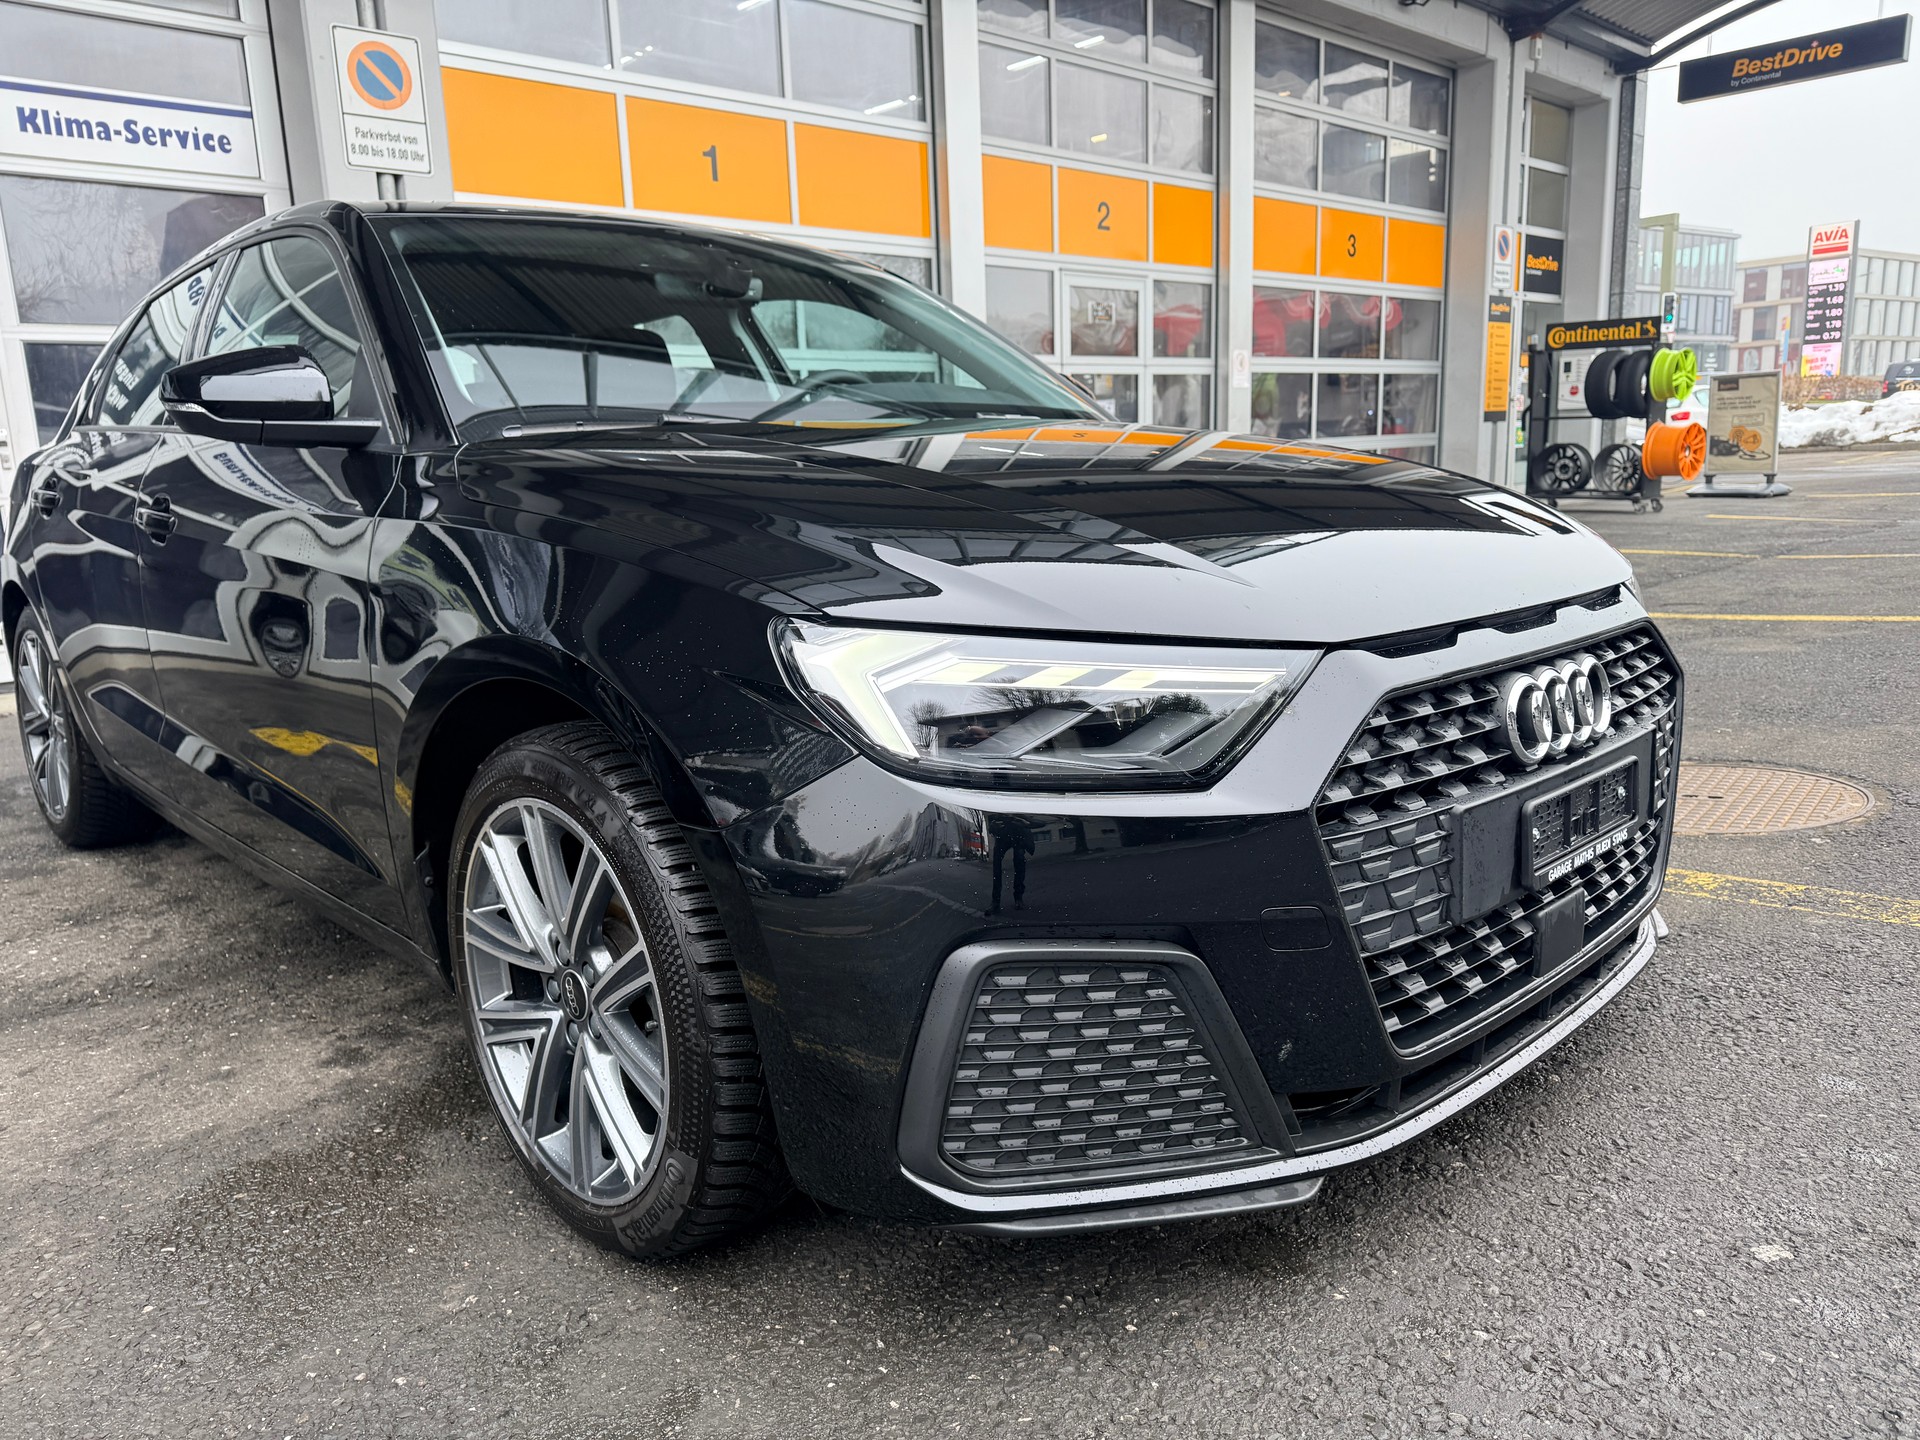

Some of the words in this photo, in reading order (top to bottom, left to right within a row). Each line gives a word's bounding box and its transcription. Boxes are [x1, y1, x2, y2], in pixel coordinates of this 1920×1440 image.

[1732, 42, 1844, 78] BestDrive
[1730, 79, 1740, 88] by
[1740, 70, 1782, 85] Continental
[15, 106, 233, 154] Klima-Service
[354, 126, 401, 143] Parkverbot
[402, 135, 418, 145] von
[350, 143, 369, 156] 8.00
[370, 145, 385, 158] bis
[386, 147, 409, 161] 18.00
[409, 150, 425, 162] Uhr
[702, 145, 719, 182] 1
[1097, 201, 1112, 232] 2
[1347, 234, 1357, 259] 3
[1813, 227, 1849, 244] AVIA
[1547, 321, 1642, 349] Continental
[1548, 859, 1573, 882] GARAGE
